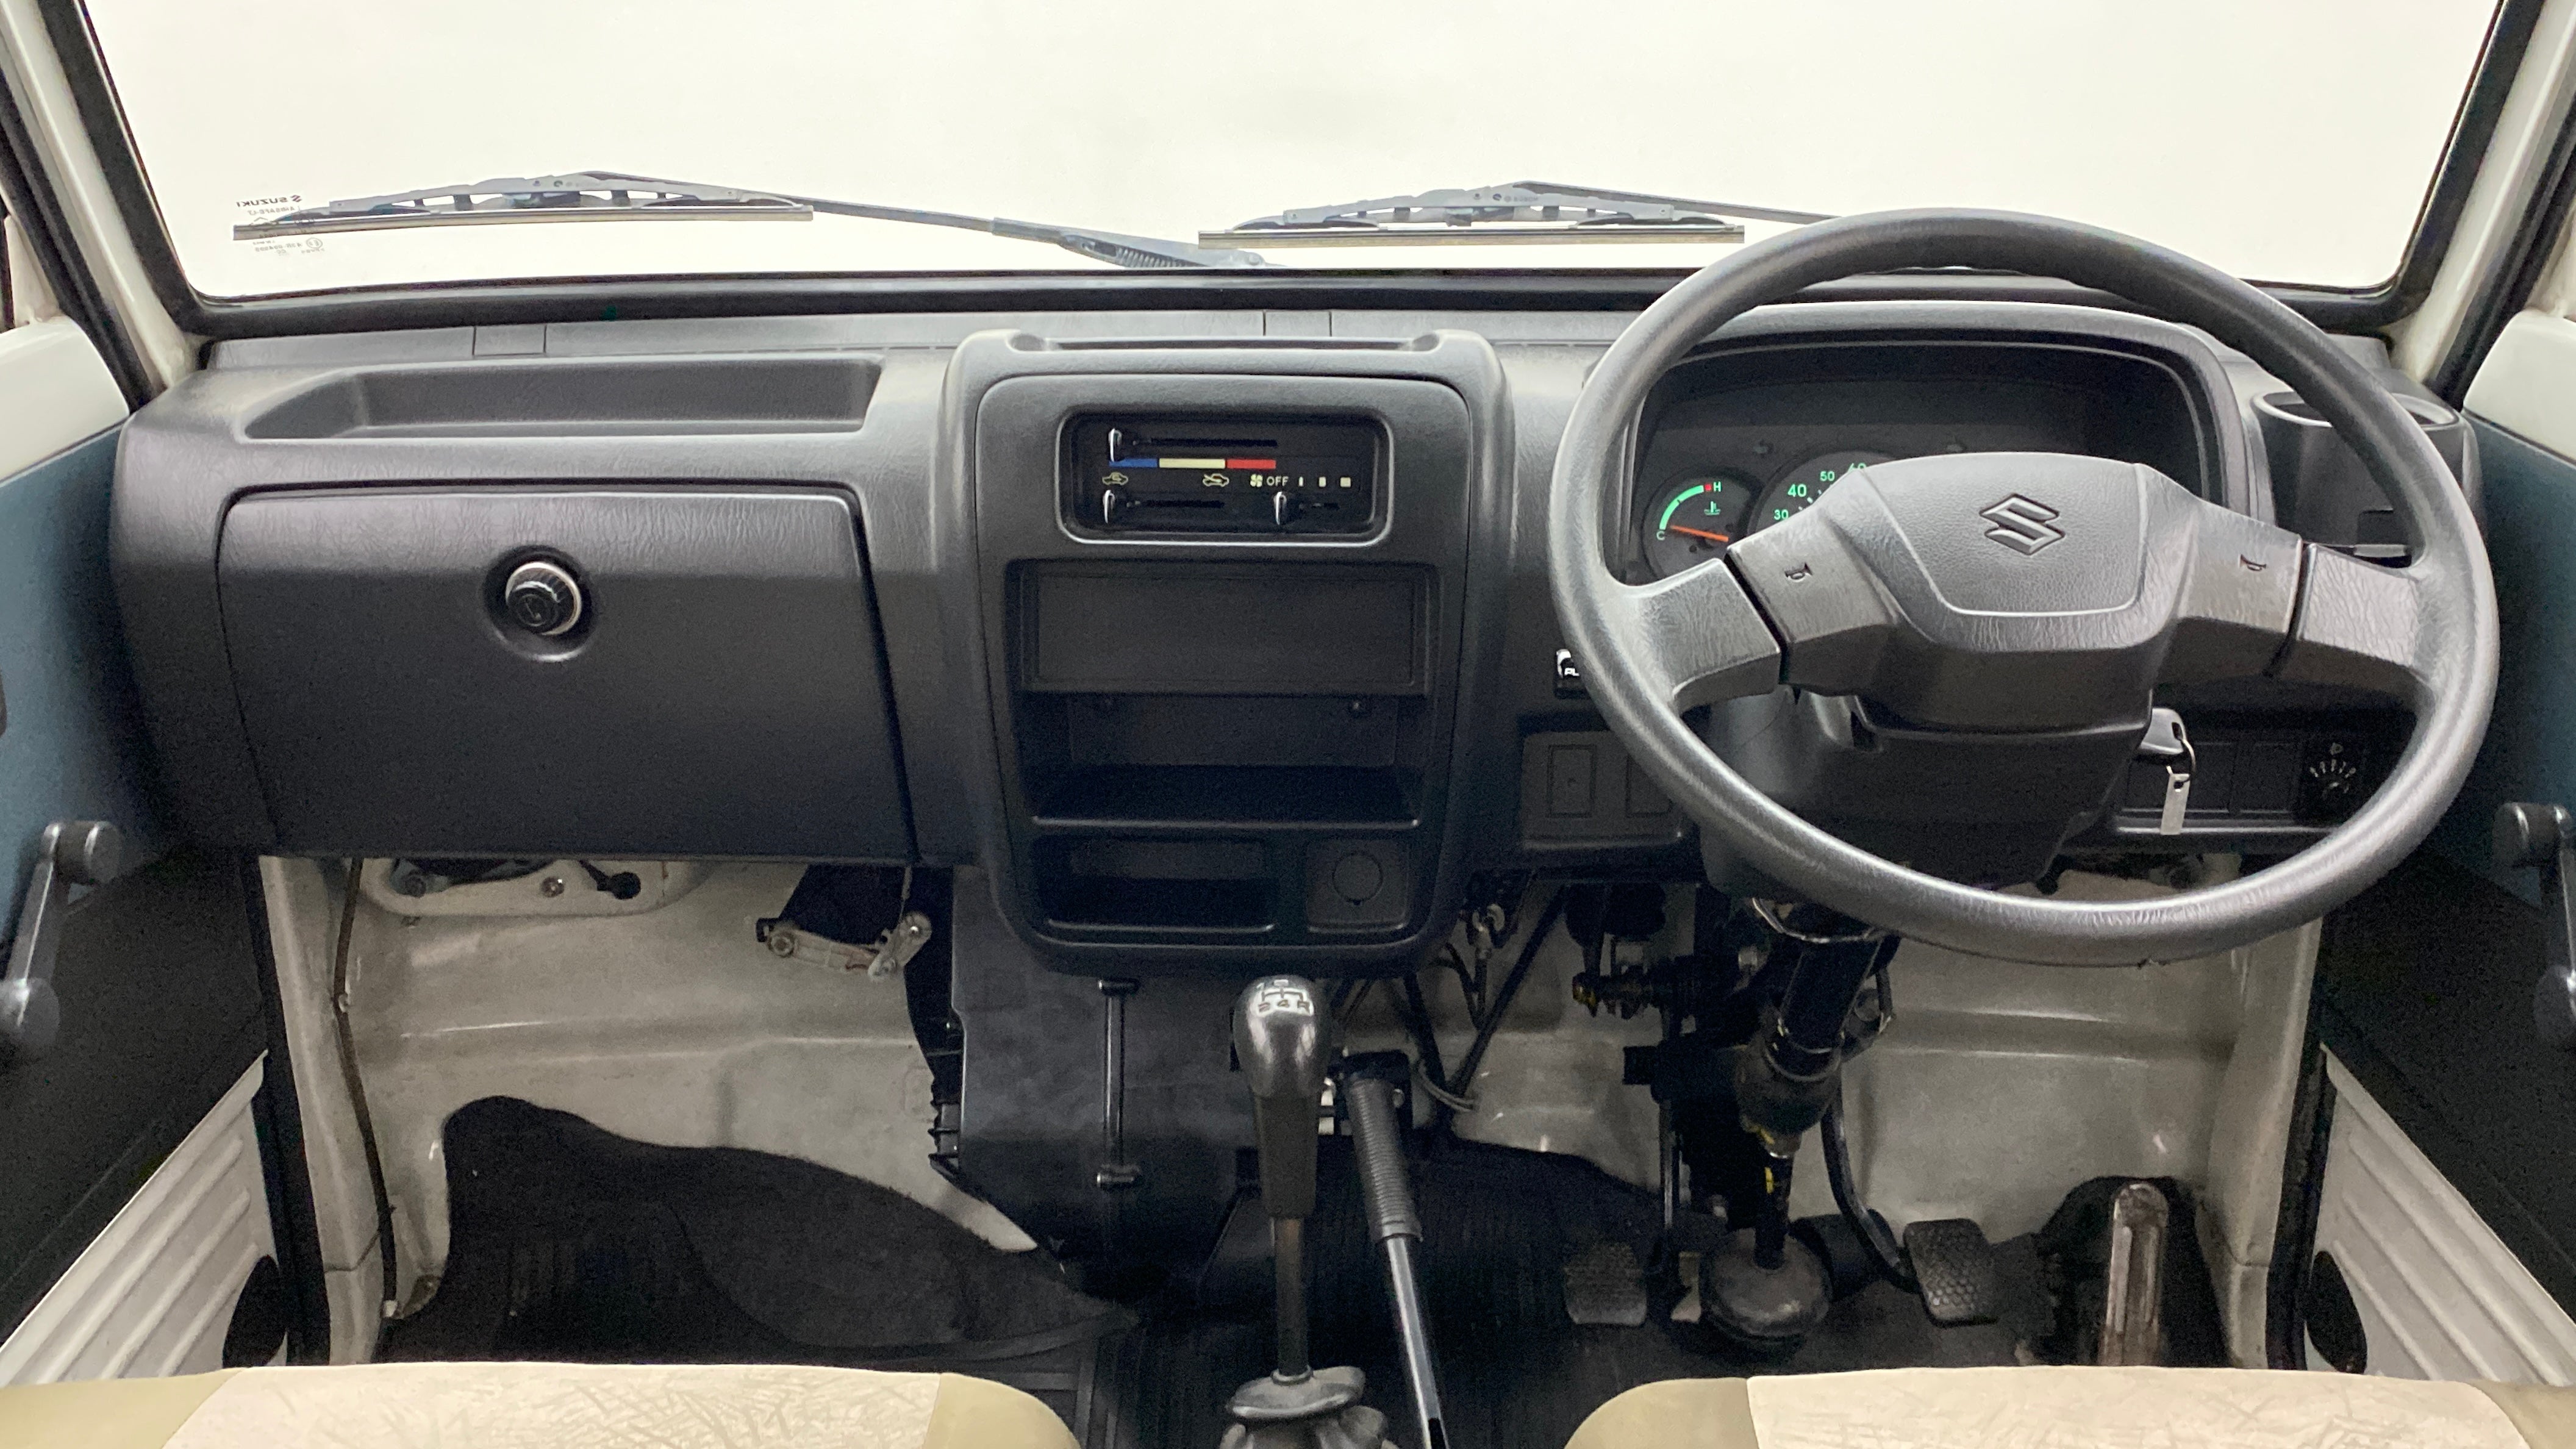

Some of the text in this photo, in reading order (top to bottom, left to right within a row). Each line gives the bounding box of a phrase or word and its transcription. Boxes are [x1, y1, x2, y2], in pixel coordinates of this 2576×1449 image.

[1266, 476, 1289, 486] OFF
[1820, 471, 1834, 481] 50
[1713, 481, 1722, 492] H
[1787, 484, 1807, 497] 40
[1773, 509, 1789, 520] 30
[1656, 530, 1665, 541] C
[1258, 999, 1311, 1012] 2 4 R
